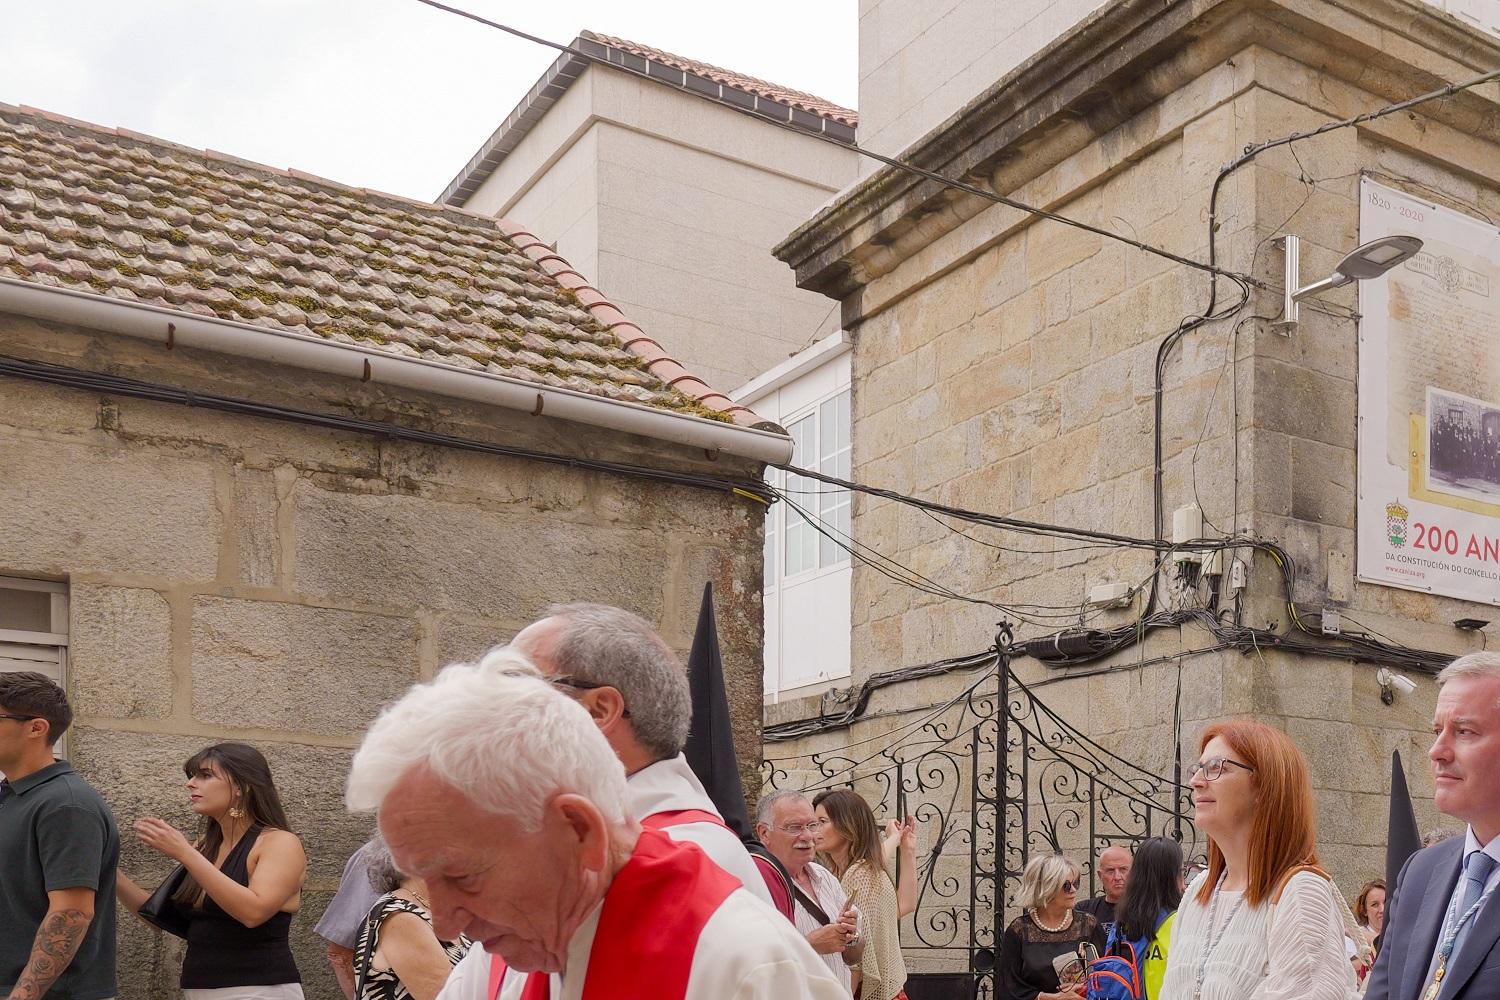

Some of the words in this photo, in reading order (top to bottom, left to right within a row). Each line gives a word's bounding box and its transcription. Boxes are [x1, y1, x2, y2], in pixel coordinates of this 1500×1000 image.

[1368, 192, 1391, 210] 1820
[1400, 206, 1424, 222] 2020
[1413, 522, 1459, 555] 200
[1385, 552, 1396, 561] DA
[1397, 554, 1450, 571] CONSTITUCIÓN
[1451, 564, 1462, 573] DO
[1463, 567, 1497, 580] CONCELLO
